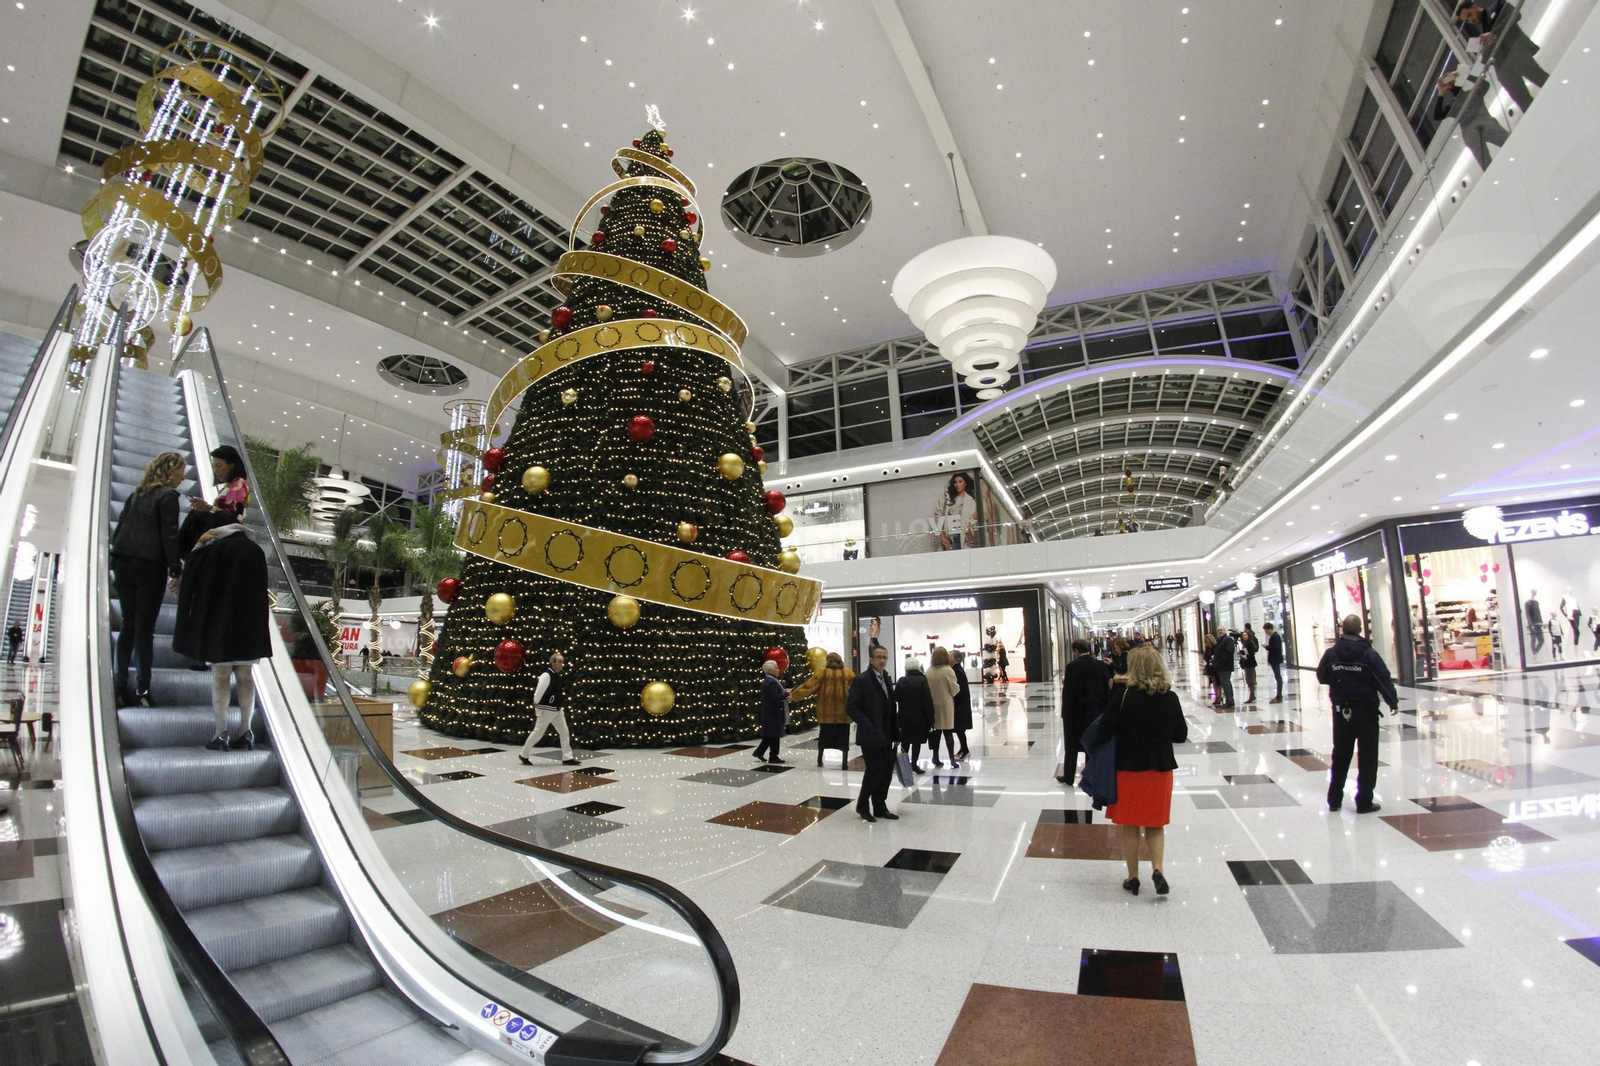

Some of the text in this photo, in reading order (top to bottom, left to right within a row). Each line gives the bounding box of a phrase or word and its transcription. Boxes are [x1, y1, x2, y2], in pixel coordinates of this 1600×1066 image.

[1486, 510, 1590, 544] EZENIS
[294, 548, 326, 560] MANG
[899, 597, 977, 612] CALZEDONIA
[539, 1035, 553, 1050] OTIS
